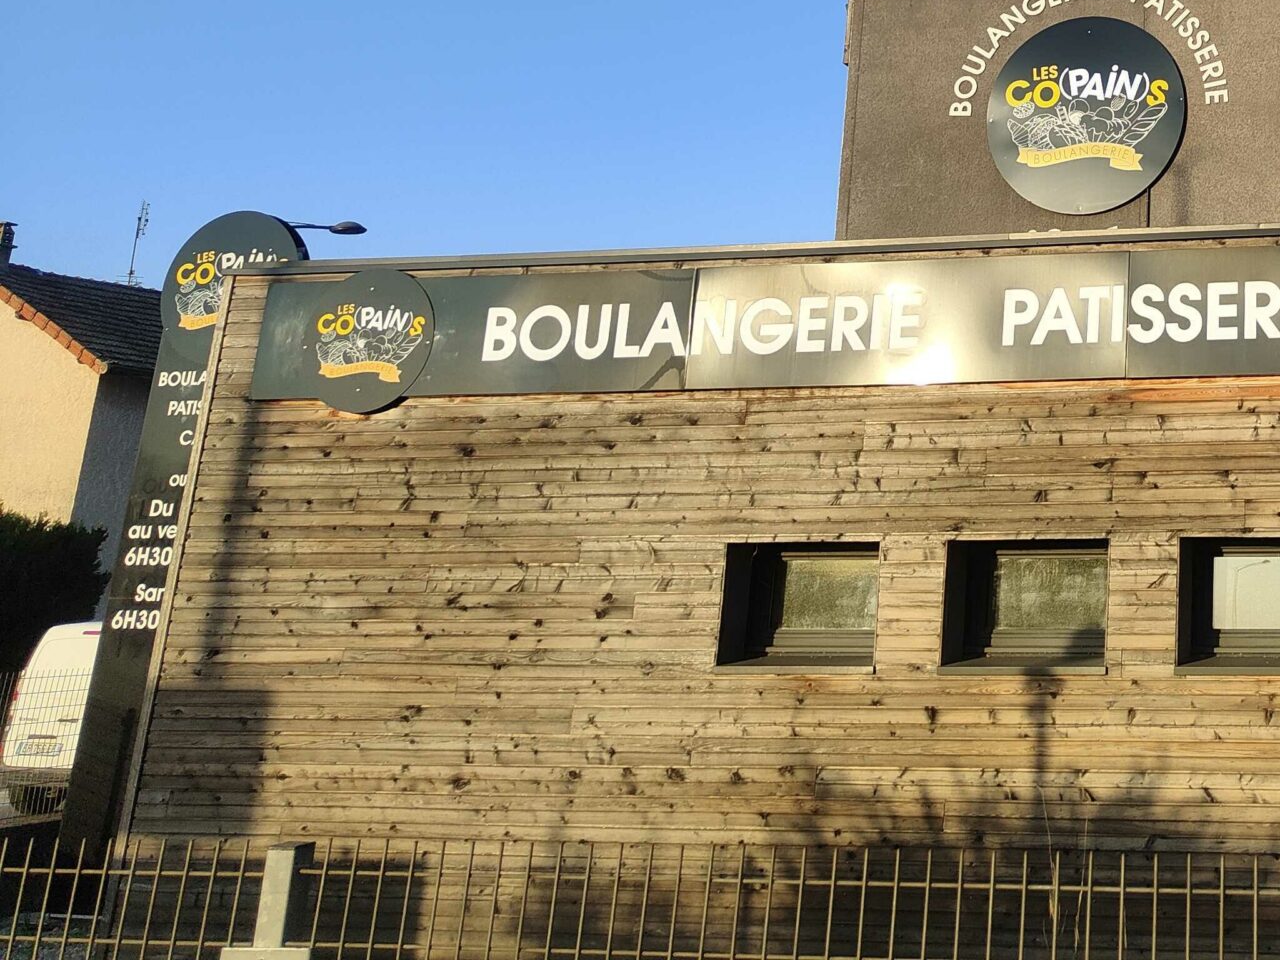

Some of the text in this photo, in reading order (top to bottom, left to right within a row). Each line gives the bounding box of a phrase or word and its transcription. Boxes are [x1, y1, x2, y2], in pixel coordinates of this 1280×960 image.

[1032, 65, 1059, 81] LES
[1033, 143, 1130, 165] BOULANGERIE
[197, 250, 216, 264] LES
[337, 303, 356, 315] LES
[481, 290, 925, 362] BOULANGERIE
[179, 430, 195, 446] C
[149, 499, 174, 517] Du
[128, 525, 153, 539] au
[124, 546, 174, 567] 6H30
[111, 609, 161, 630] 6H30
